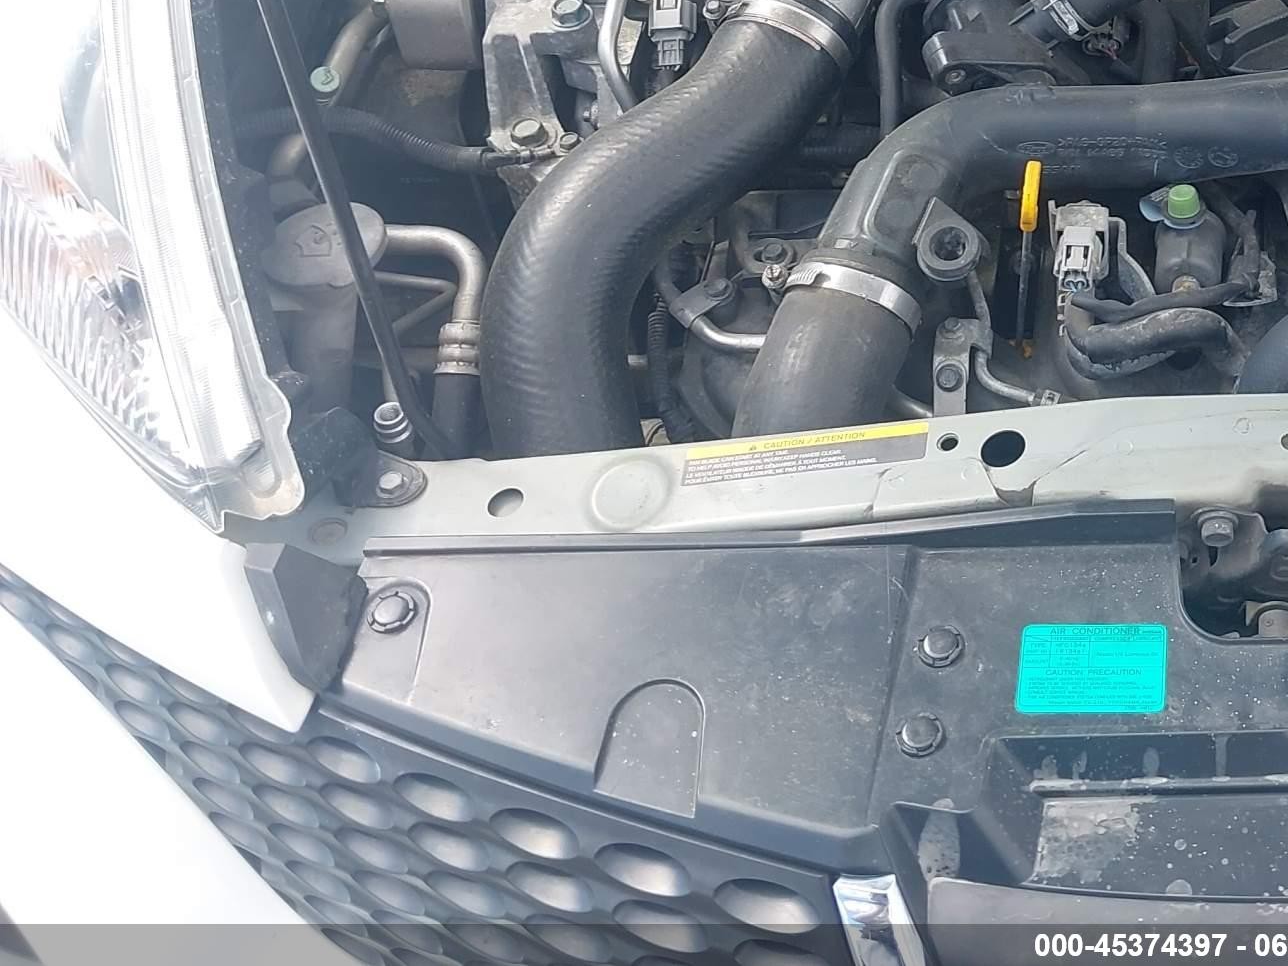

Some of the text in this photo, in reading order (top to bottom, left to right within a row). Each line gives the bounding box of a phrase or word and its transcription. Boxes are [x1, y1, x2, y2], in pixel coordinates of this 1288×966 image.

[763, 440, 805, 449] CAUTION
[814, 432, 865, 443] ATTENTION
[1072, 627, 1140, 636] CONDITIONER
